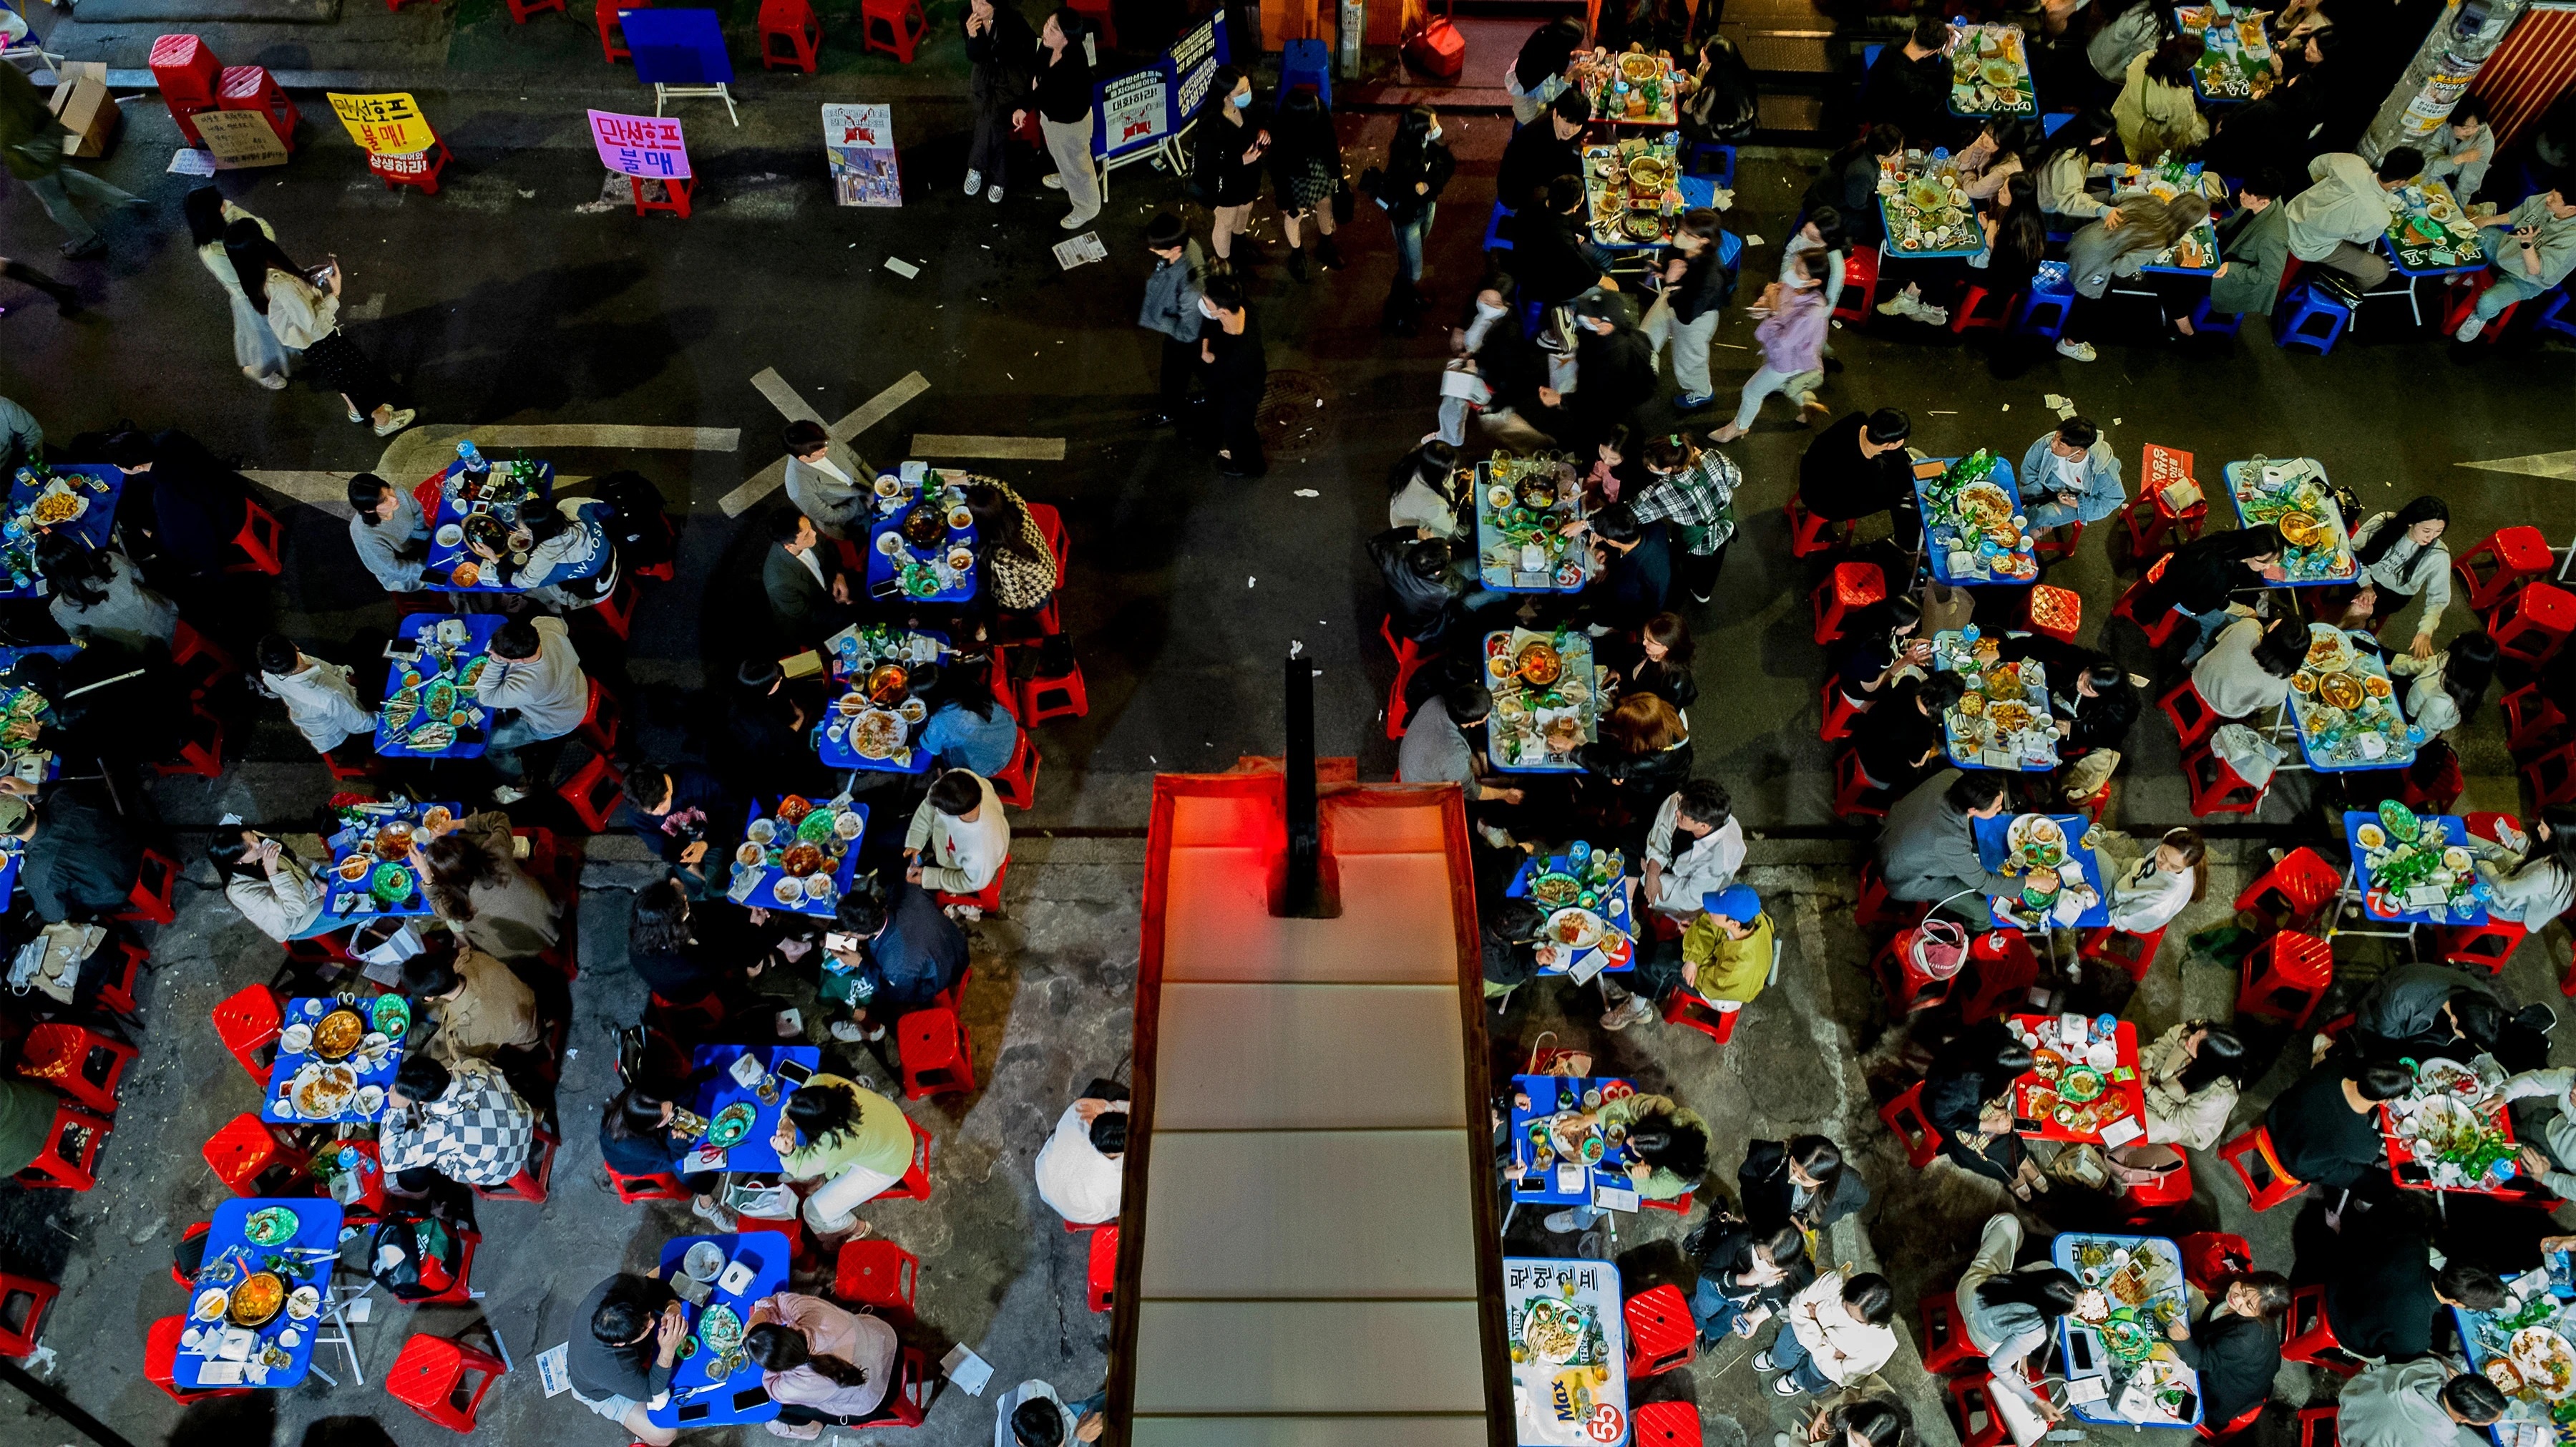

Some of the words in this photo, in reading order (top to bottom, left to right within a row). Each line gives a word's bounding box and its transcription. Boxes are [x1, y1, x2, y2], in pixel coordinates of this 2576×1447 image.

[333, 98, 414, 122] 만선호프
[1112, 87, 1158, 112] 대화하라!
[361, 123, 407, 151] 불매!
[596, 117, 682, 151] 만선호프
[370, 155, 427, 174] 상생하라!
[619, 148, 674, 175] 불매
[1511, 1265, 1599, 1291] 뮌헨호프
[1513, 1309, 1522, 1335] TERRA
[1579, 1335, 1589, 1363] TERRA
[1551, 1380, 1575, 1422] Max
[1593, 1405, 1616, 1439] 55
